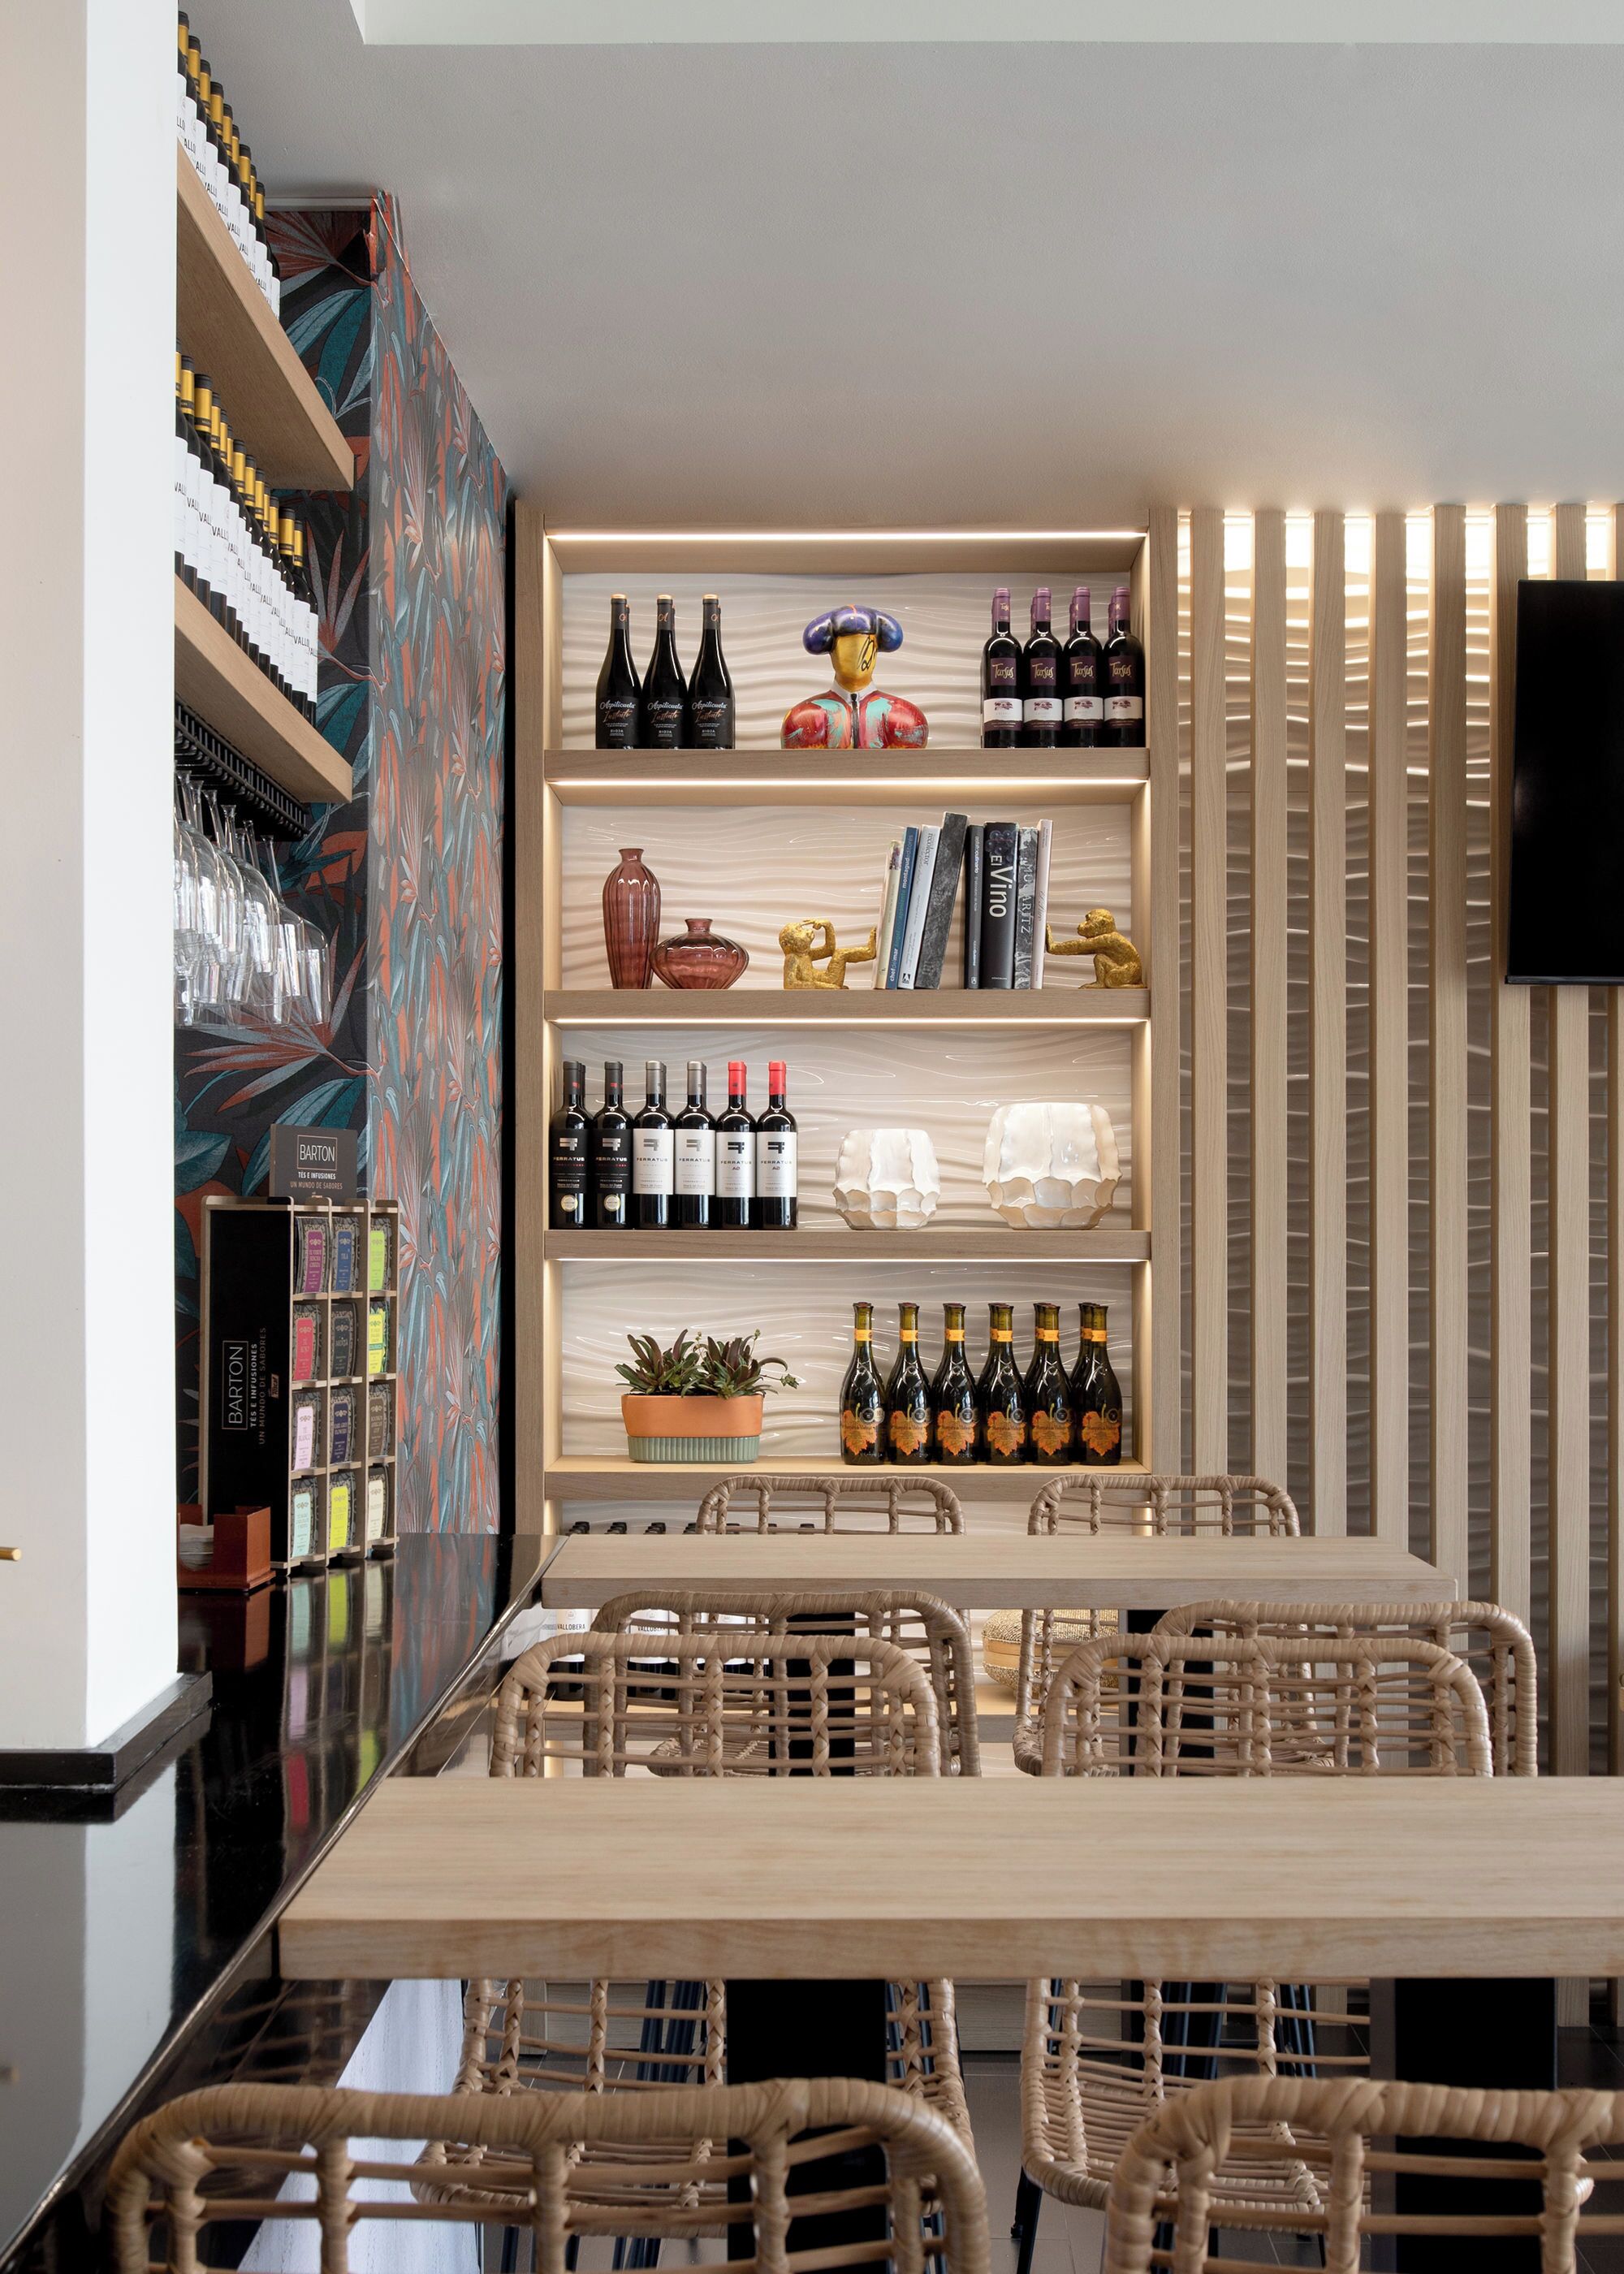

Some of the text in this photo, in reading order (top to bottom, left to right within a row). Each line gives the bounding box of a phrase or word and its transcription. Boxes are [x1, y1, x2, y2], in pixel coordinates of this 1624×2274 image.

[600, 699, 636, 709] Azpilicueta
[647, 700, 684, 710] Azpilicueta
[692, 700, 728, 709] Azpilicueta
[924, 832, 933, 866] recolector
[989, 855, 1013, 918] El Vino
[300, 1144, 335, 1161] BARTON
[228, 1347, 244, 1424] BARTON
[259, 1375, 266, 1388] DE
[249, 1411, 257, 1427] TÉS
[258, 1431, 266, 1445] UN
